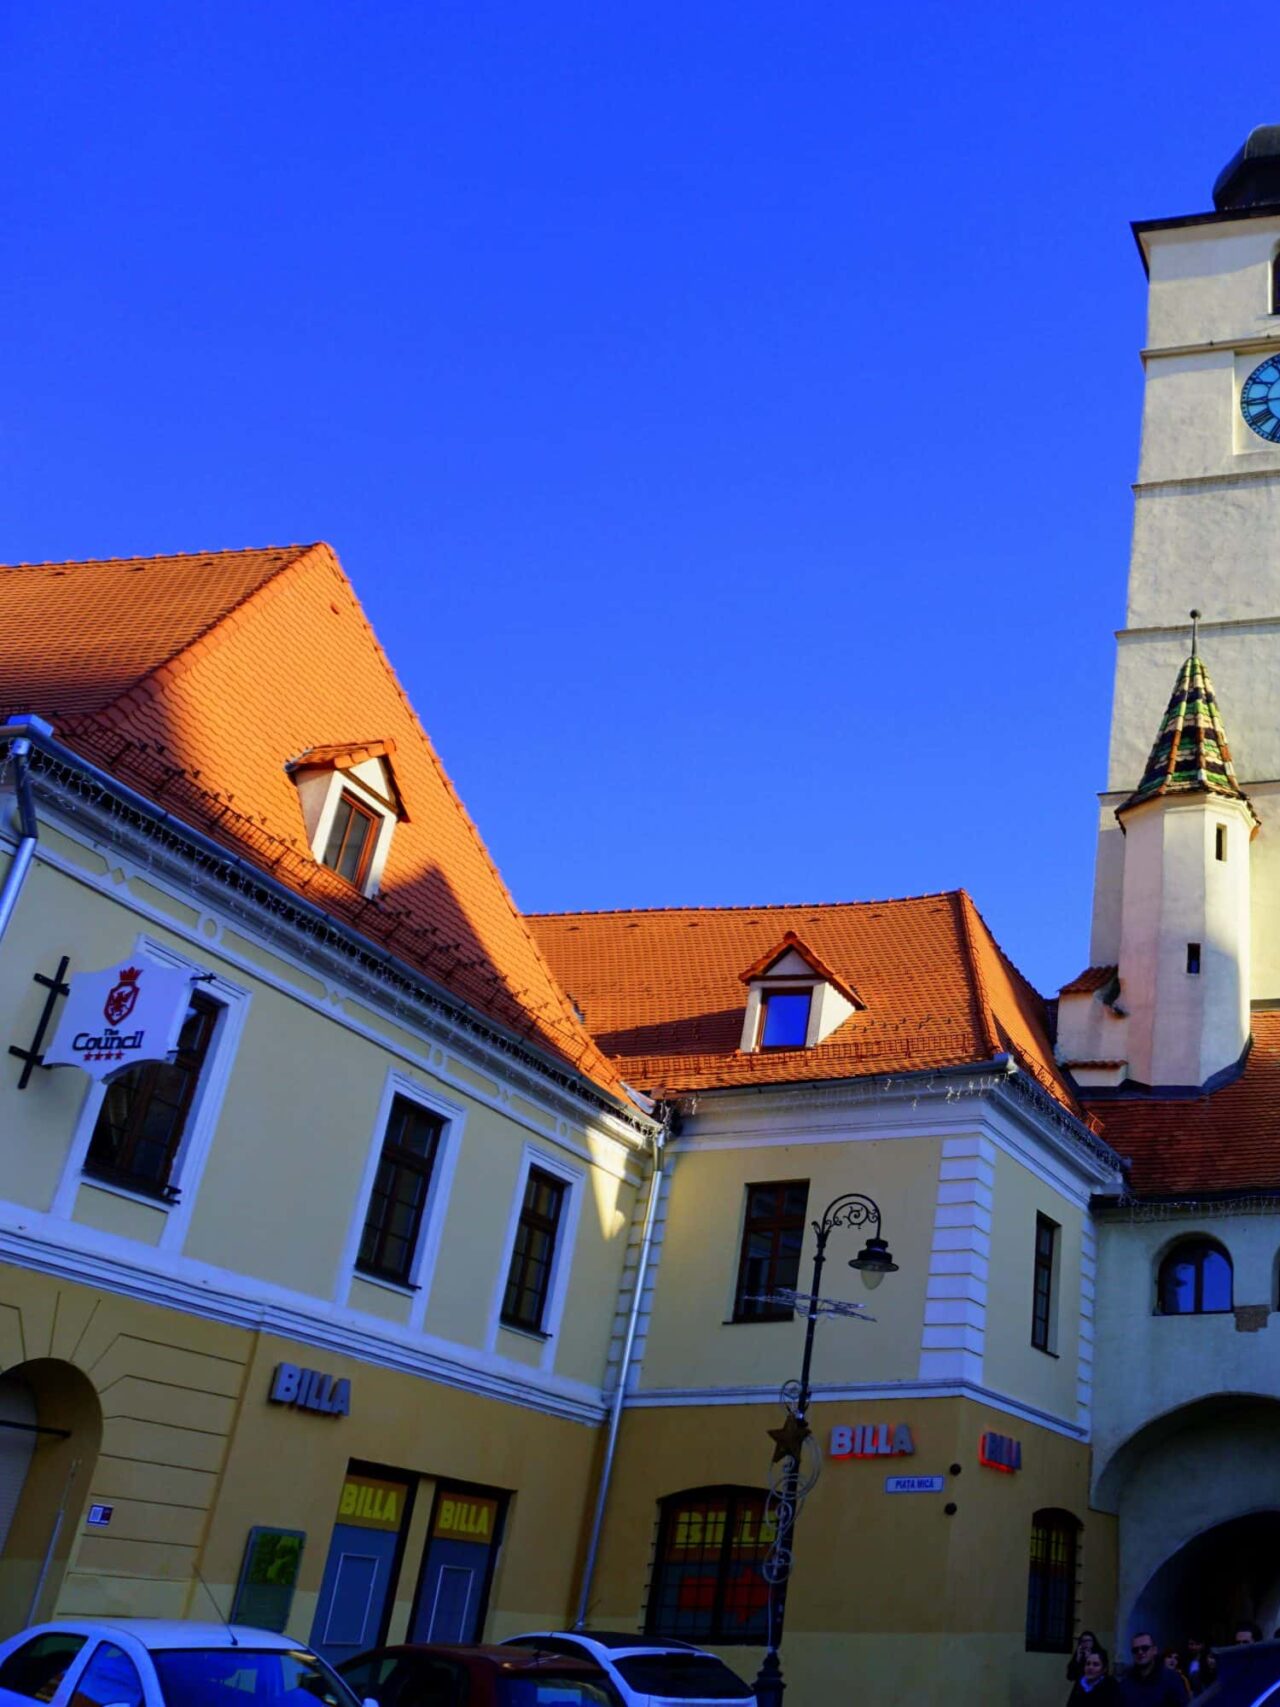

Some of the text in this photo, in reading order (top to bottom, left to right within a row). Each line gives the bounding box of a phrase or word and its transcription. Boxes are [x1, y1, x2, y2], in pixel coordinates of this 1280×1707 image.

[72, 1031, 144, 1050] Council
[104, 1028, 119, 1036] The
[269, 1362, 351, 1416] BILLA
[829, 1423, 914, 1458] BILLA
[339, 1483, 398, 1522] BILLA
[438, 1499, 490, 1535] BILLA
